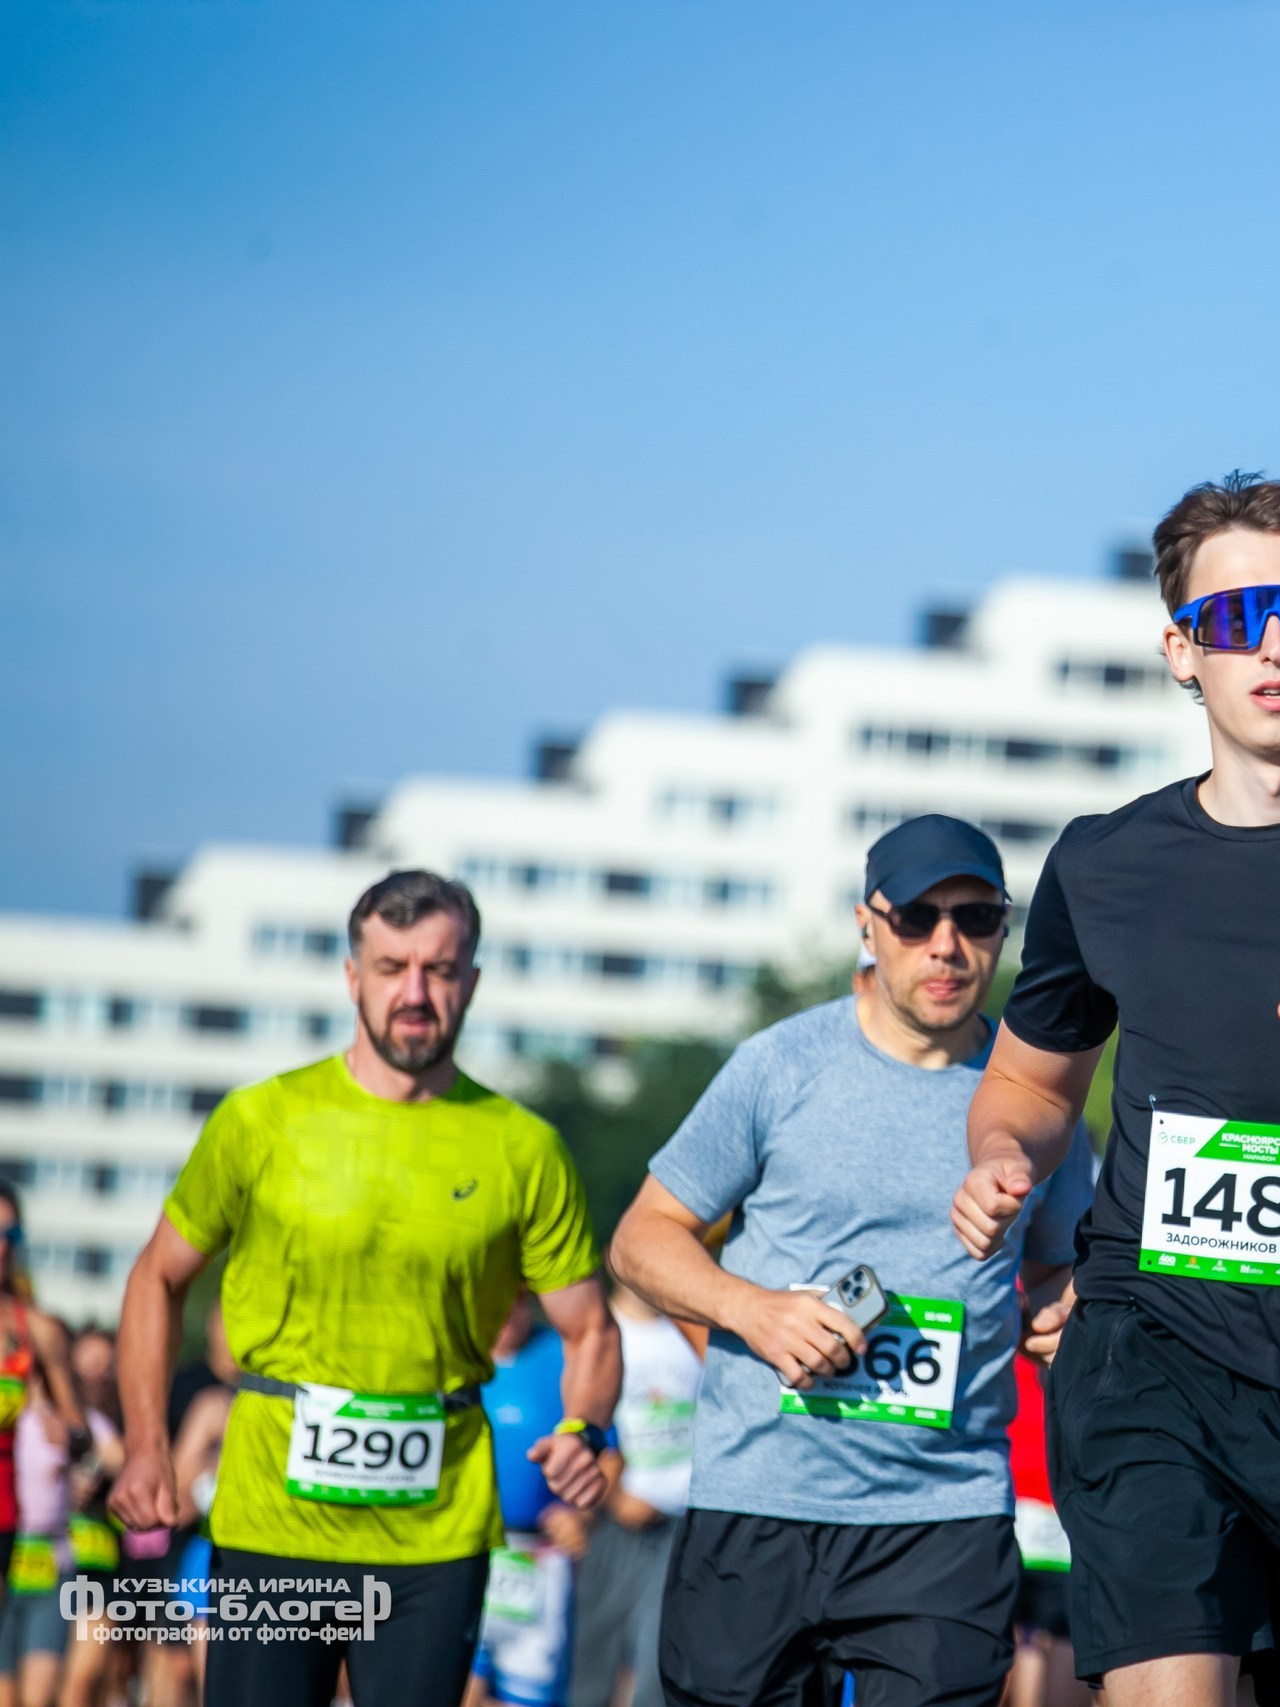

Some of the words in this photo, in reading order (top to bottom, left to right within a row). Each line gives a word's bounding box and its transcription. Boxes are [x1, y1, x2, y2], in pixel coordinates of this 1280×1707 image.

[1170, 1135, 1196, 1145] СБЕР
[1241, 1143, 1279, 1155] МОСТЫ
[1242, 1153, 1277, 1162] МАРАФОН
[1166, 1232, 1277, 1254] ЗАДОРОЖНИКОВ
[835, 1333, 941, 1385] 66
[303, 1424, 431, 1470] 1290
